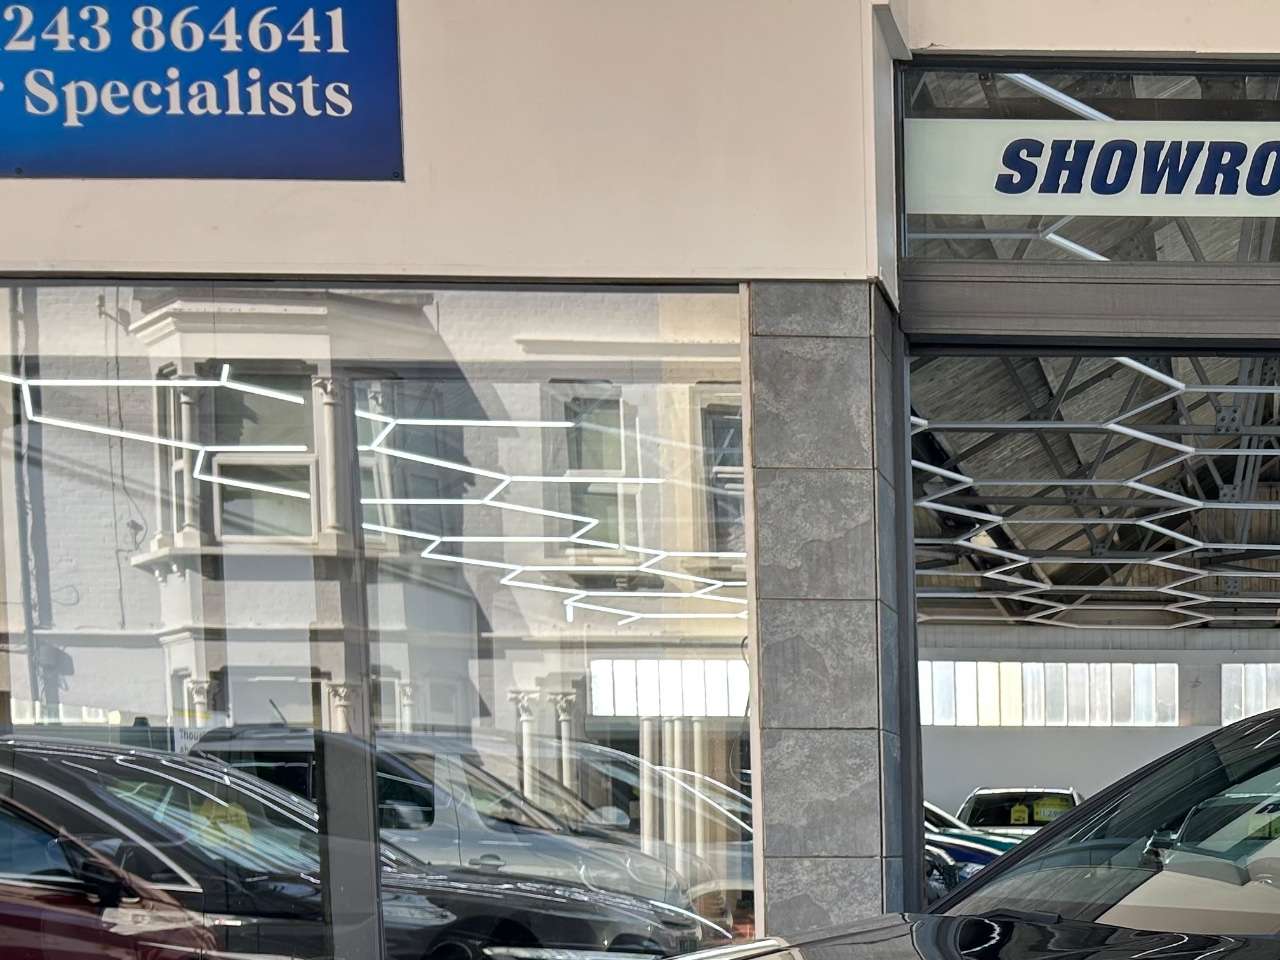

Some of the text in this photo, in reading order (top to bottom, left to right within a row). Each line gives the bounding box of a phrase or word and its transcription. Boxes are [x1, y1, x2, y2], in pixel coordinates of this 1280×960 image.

[0, 5, 350, 53] 243 864641
[24, 67, 353, 127] Specialists
